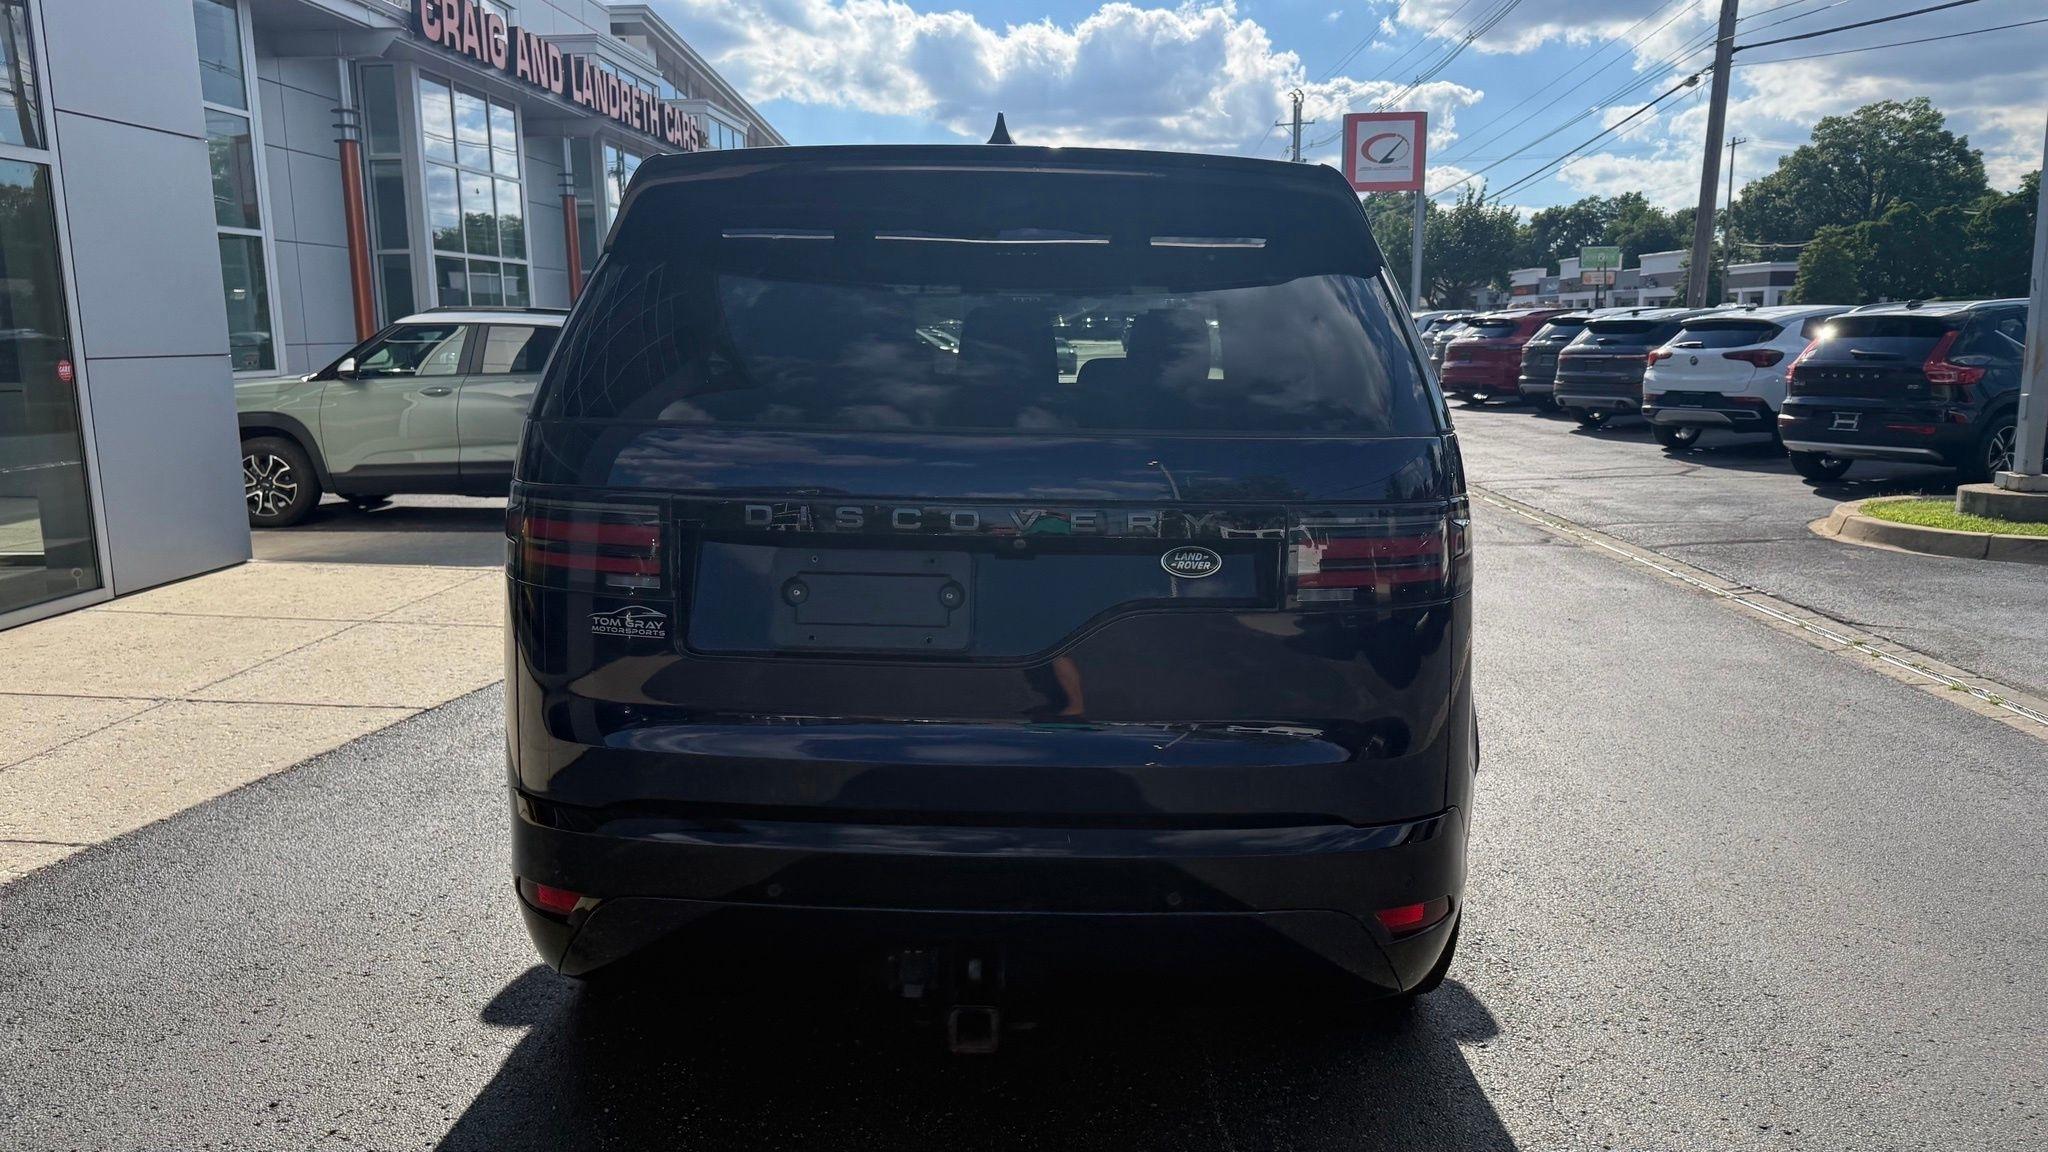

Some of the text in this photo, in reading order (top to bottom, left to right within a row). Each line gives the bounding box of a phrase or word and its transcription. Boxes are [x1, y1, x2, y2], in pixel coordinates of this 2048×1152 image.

[420, 0, 699, 152] CRAIG AND LANDRETH CARS
[745, 503, 1214, 534] DISCOVERY
[592, 625, 666, 636] MOTORSPORTS
[593, 617, 664, 630] TOM GRAY
